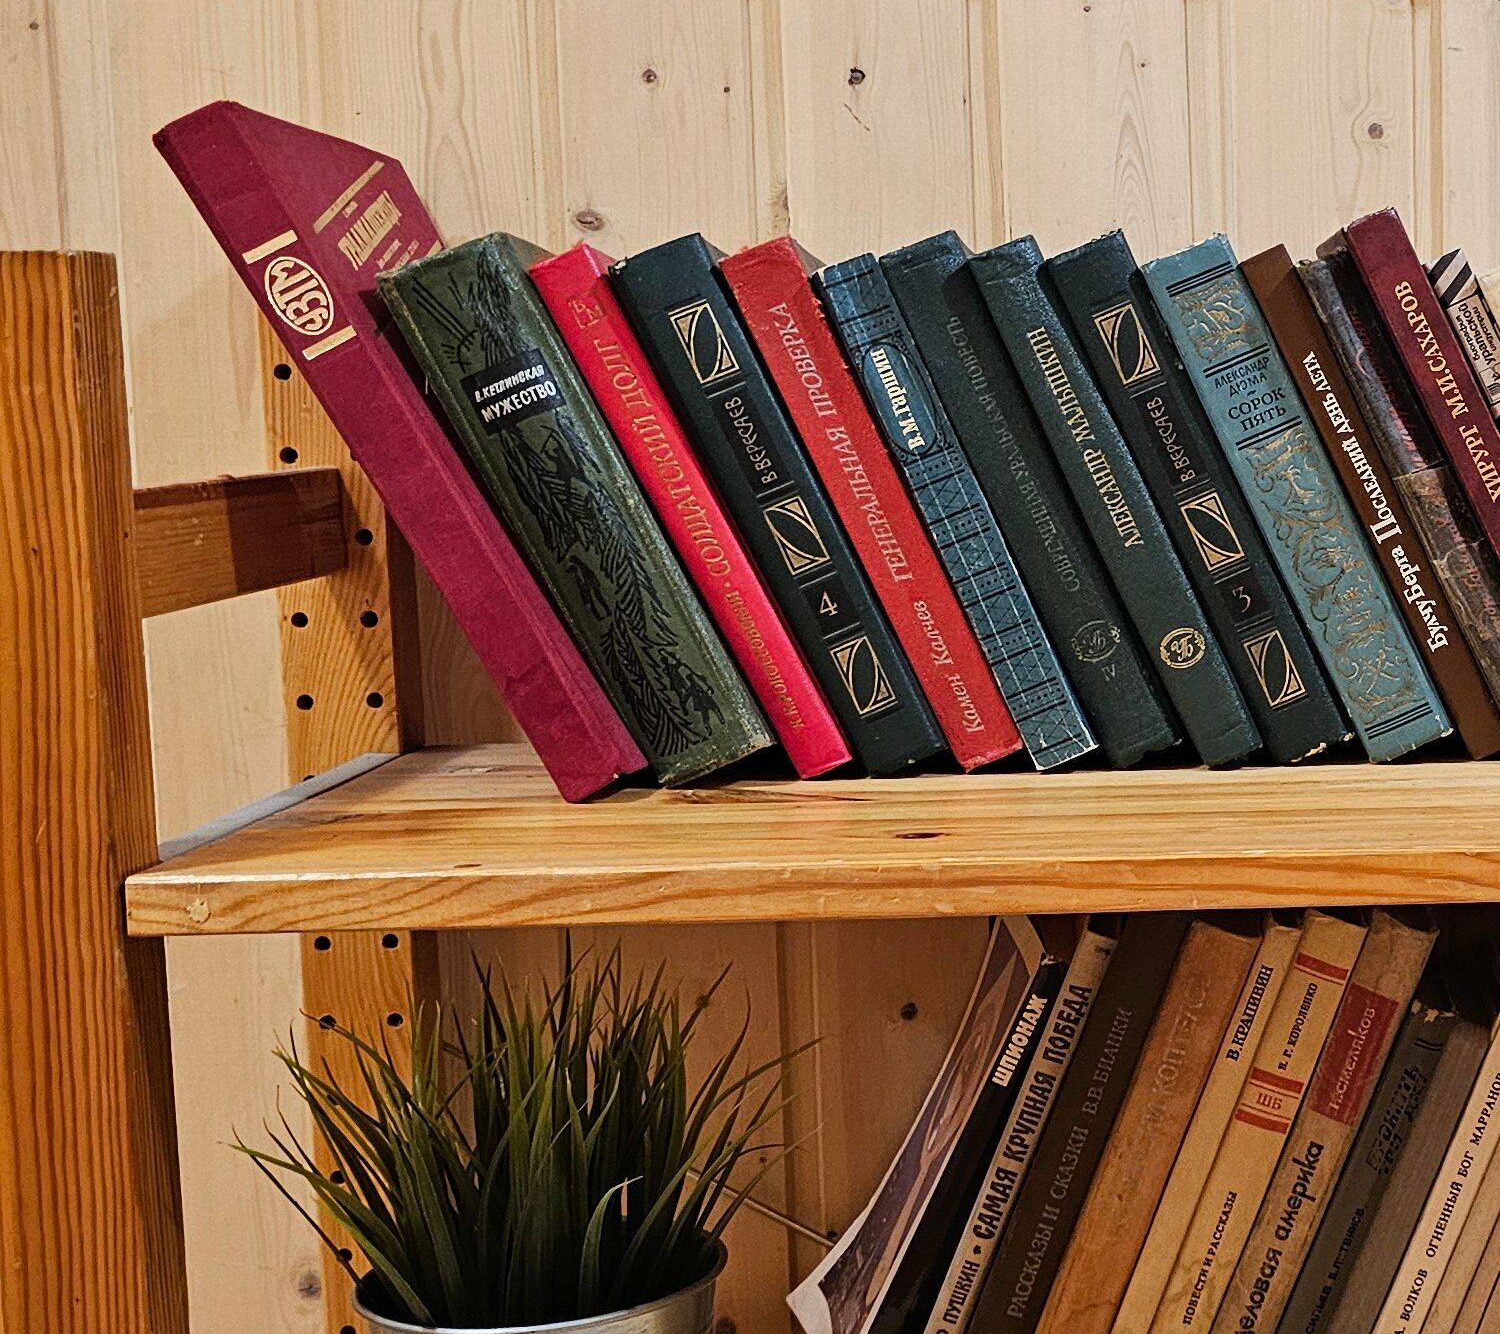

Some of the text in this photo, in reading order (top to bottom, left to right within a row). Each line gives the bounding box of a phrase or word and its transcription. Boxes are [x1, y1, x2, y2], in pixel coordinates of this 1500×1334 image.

[1452, 314, 1482, 361] биография
[1455, 301, 1497, 366] уральской
[482, 380, 557, 424] МУЖЕСТВО
[592, 331, 650, 416] ДОЛГ
[1212, 355, 1271, 389] АЛЕКСАНДР
[1226, 369, 1268, 397] ДЮМА
[1226, 385, 1285, 421] СОРОК
[1025, 324, 1144, 550] АЛЕКСАНДР МАЛЫШКИН
[1238, 402, 1287, 432] ПЯТЬ
[942, 313, 1083, 593] СОВРЕМЕННАЯ УРАЛЬСКАЯ ПОВЕСТЬ
[631, 409, 733, 581] СОЛДАТСКИЙ
[766, 300, 986, 735] Камен Калчев ГЕНЕРАЛЬНАЯ ПРОВЕРКА
[813, 589, 840, 620] 4
[1232, 589, 1251, 615] 3
[991, 991, 1048, 1088] ШПИОНАЖ
[1285, 981, 1318, 1047] КОРОЛЕНКО
[1256, 1092, 1283, 1111] ШБ
[940, 1258, 981, 1325] ПУШКИН
[971, 1165, 1020, 1242] САМАЯ
[1001, 1068, 1058, 1164] КРУПНАЯ
[1040, 980, 1094, 1067] ПОБЕДА
[1048, 1124, 1089, 1201] СКАЗКИ
[1041, 1202, 1061, 1221] И
[1399, 1266, 1430, 1320] ВОЛКОВ
[1421, 1178, 1464, 1259] ОГНЕННЫЙ
[1454, 1149, 1476, 1178] БОГ
[1004, 1222, 1054, 1320] РАССКАЗЫ
[1181, 1190, 1238, 1325] ПОВЕСТИ И РАССКАЗЫ
